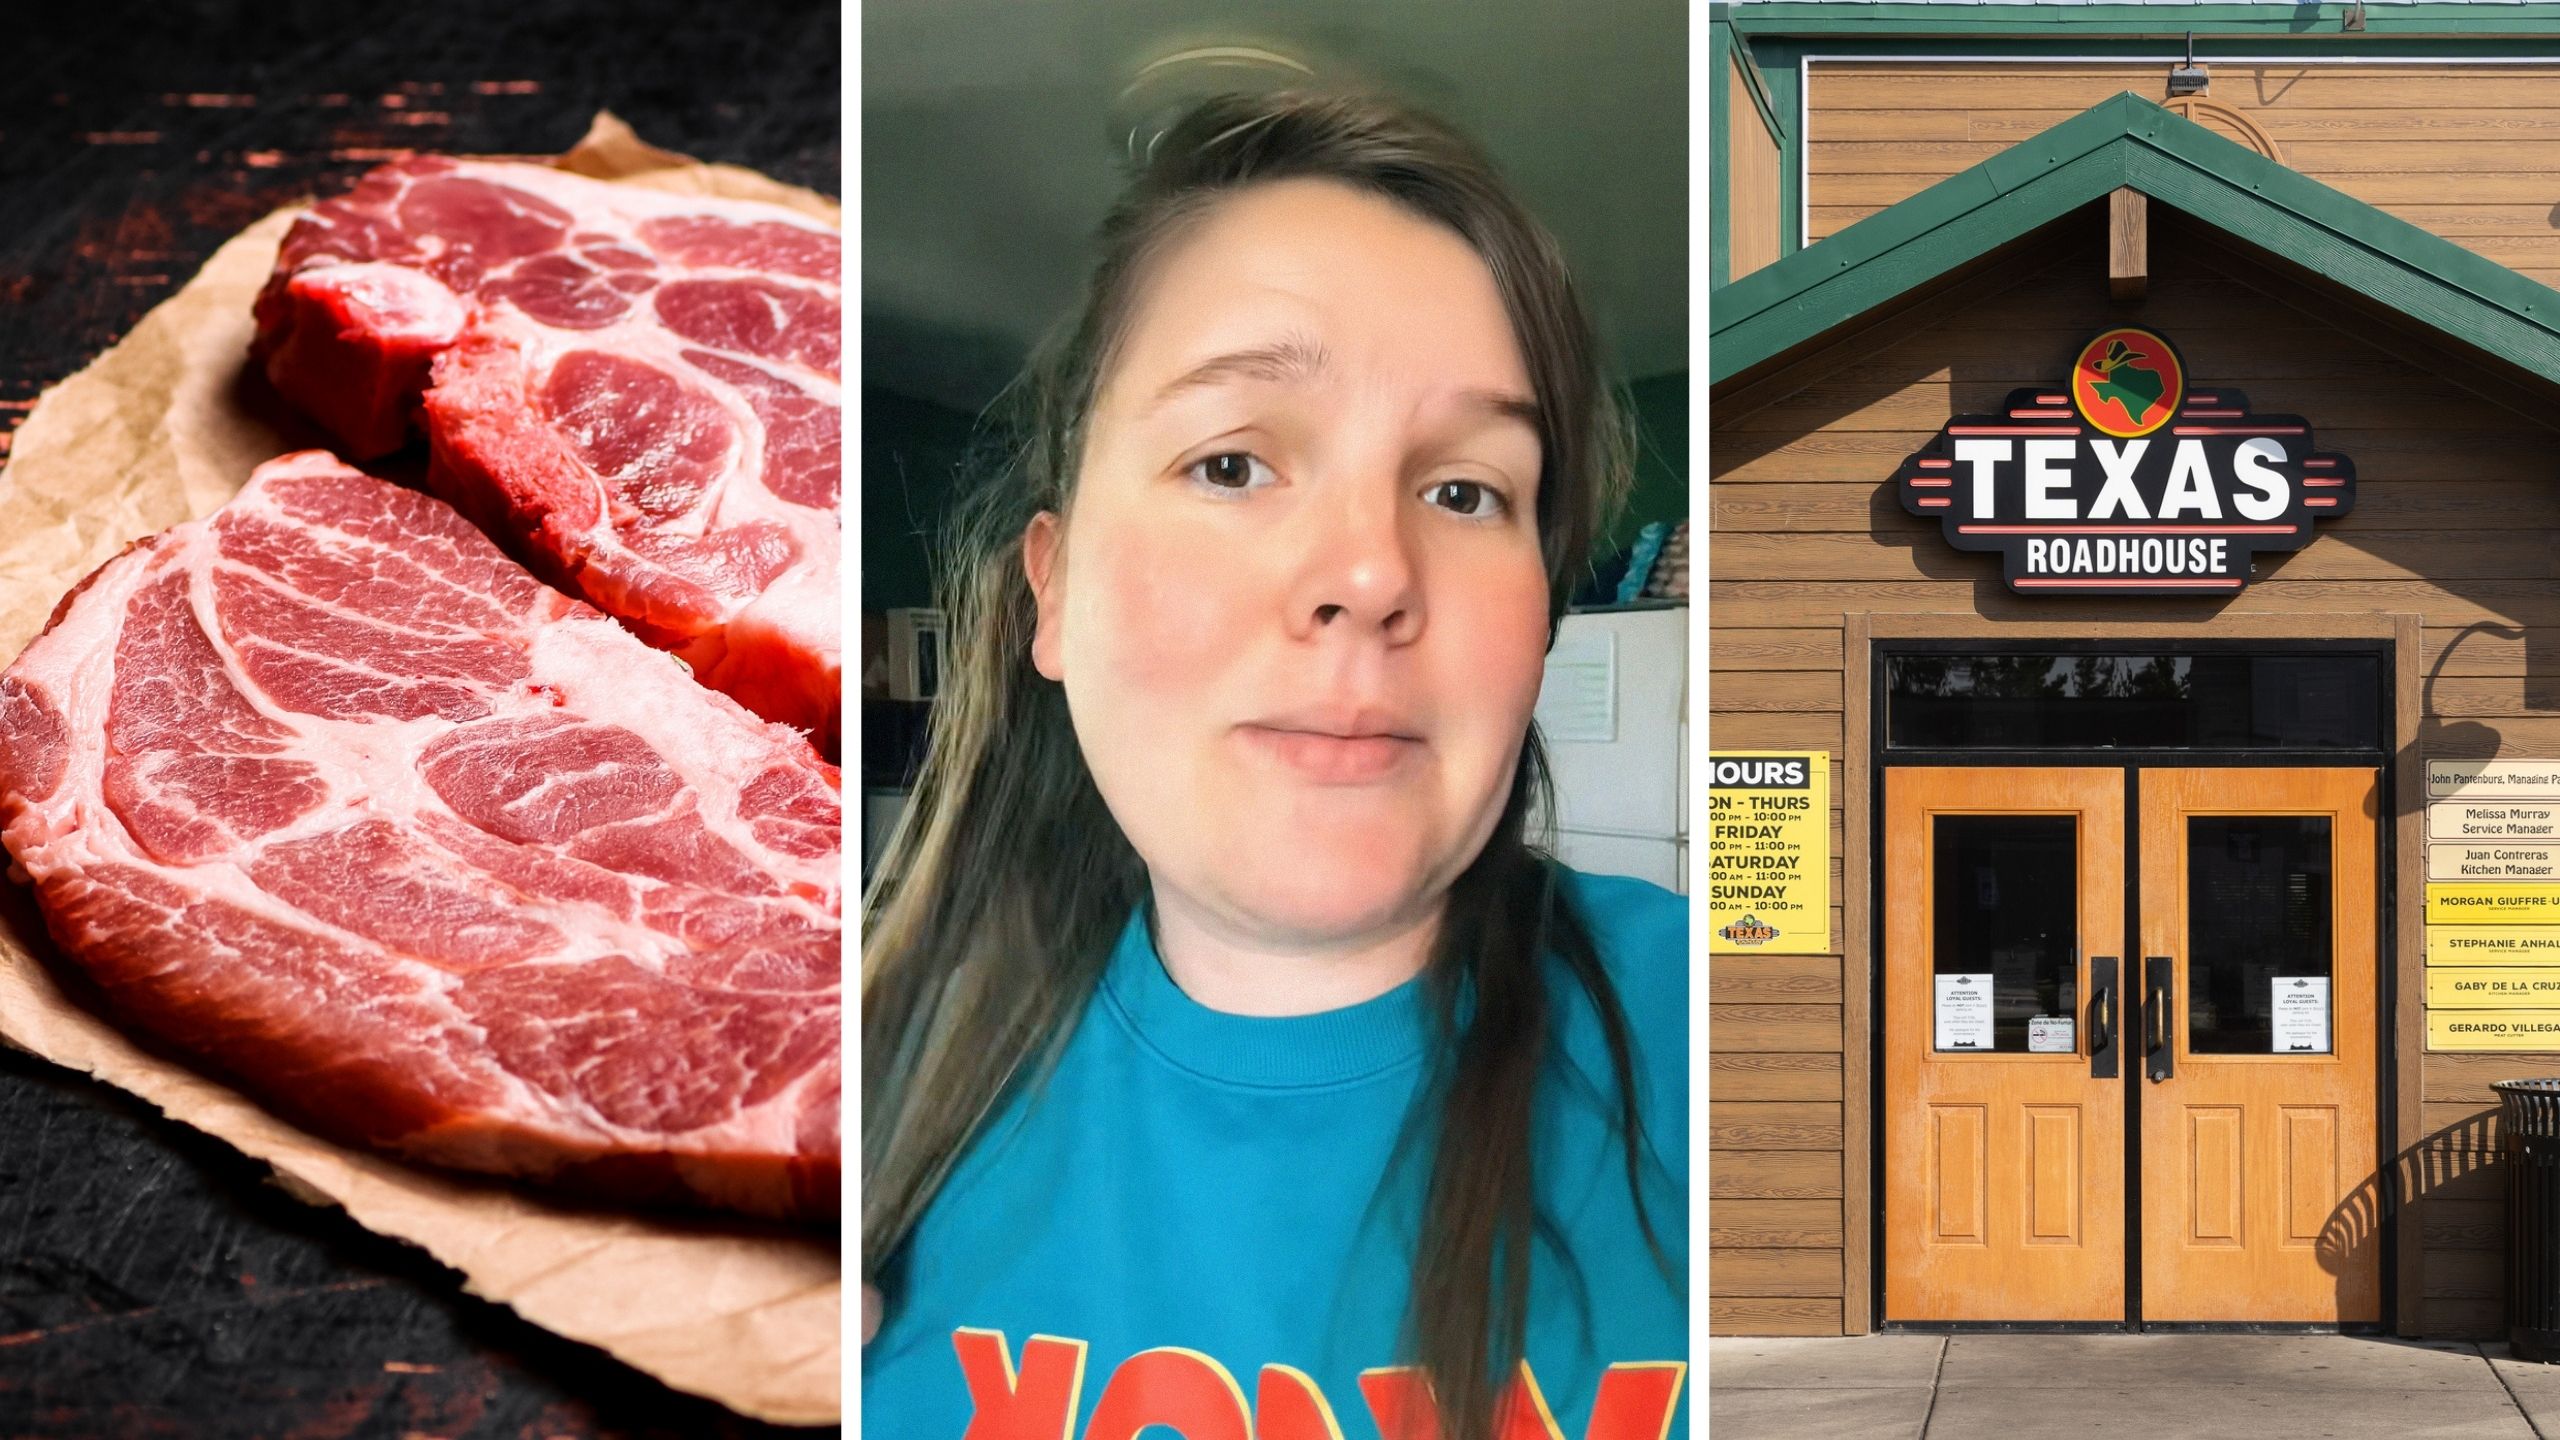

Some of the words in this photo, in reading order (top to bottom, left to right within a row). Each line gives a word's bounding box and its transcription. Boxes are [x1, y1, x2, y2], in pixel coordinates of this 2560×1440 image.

[1955, 437, 2290, 521] TEXAS
[2027, 538, 2227, 573] ROADHOUSE
[2431, 773, 2451, 784] John
[2507, 774, 2549, 785] Managing
[1749, 796, 1810, 810] THURS
[1754, 812, 1786, 821] 10:00
[2466, 809, 2506, 819] Melissa
[2509, 809, 2551, 819] Murray
[1715, 825, 1783, 839] FRIDAY
[2462, 823, 2503, 834] Service
[2506, 824, 2554, 834] Manager
[1755, 841, 1785, 850] 11:00
[2465, 849, 2491, 860] Juan
[2494, 850, 2549, 860] Contreras
[1709, 855, 1800, 869] ATURDAY
[2461, 864, 2501, 875] Kitchen
[2505, 865, 2553, 875] Manager
[1756, 871, 1786, 880] 11:00
[1711, 885, 1787, 899] SUNDAY
[1755, 901, 1788, 910] 10:00
[2440, 897, 2493, 906] MORGAN
[1728, 927, 1772, 939] TEXAS
[2449, 939, 2516, 948] STEPHANIE
[2454, 982, 2488, 991] GABY
[2492, 982, 2508, 991] DE
[2512, 982, 2528, 991] LA
[2448, 1024, 2507, 1033] GERARDO
